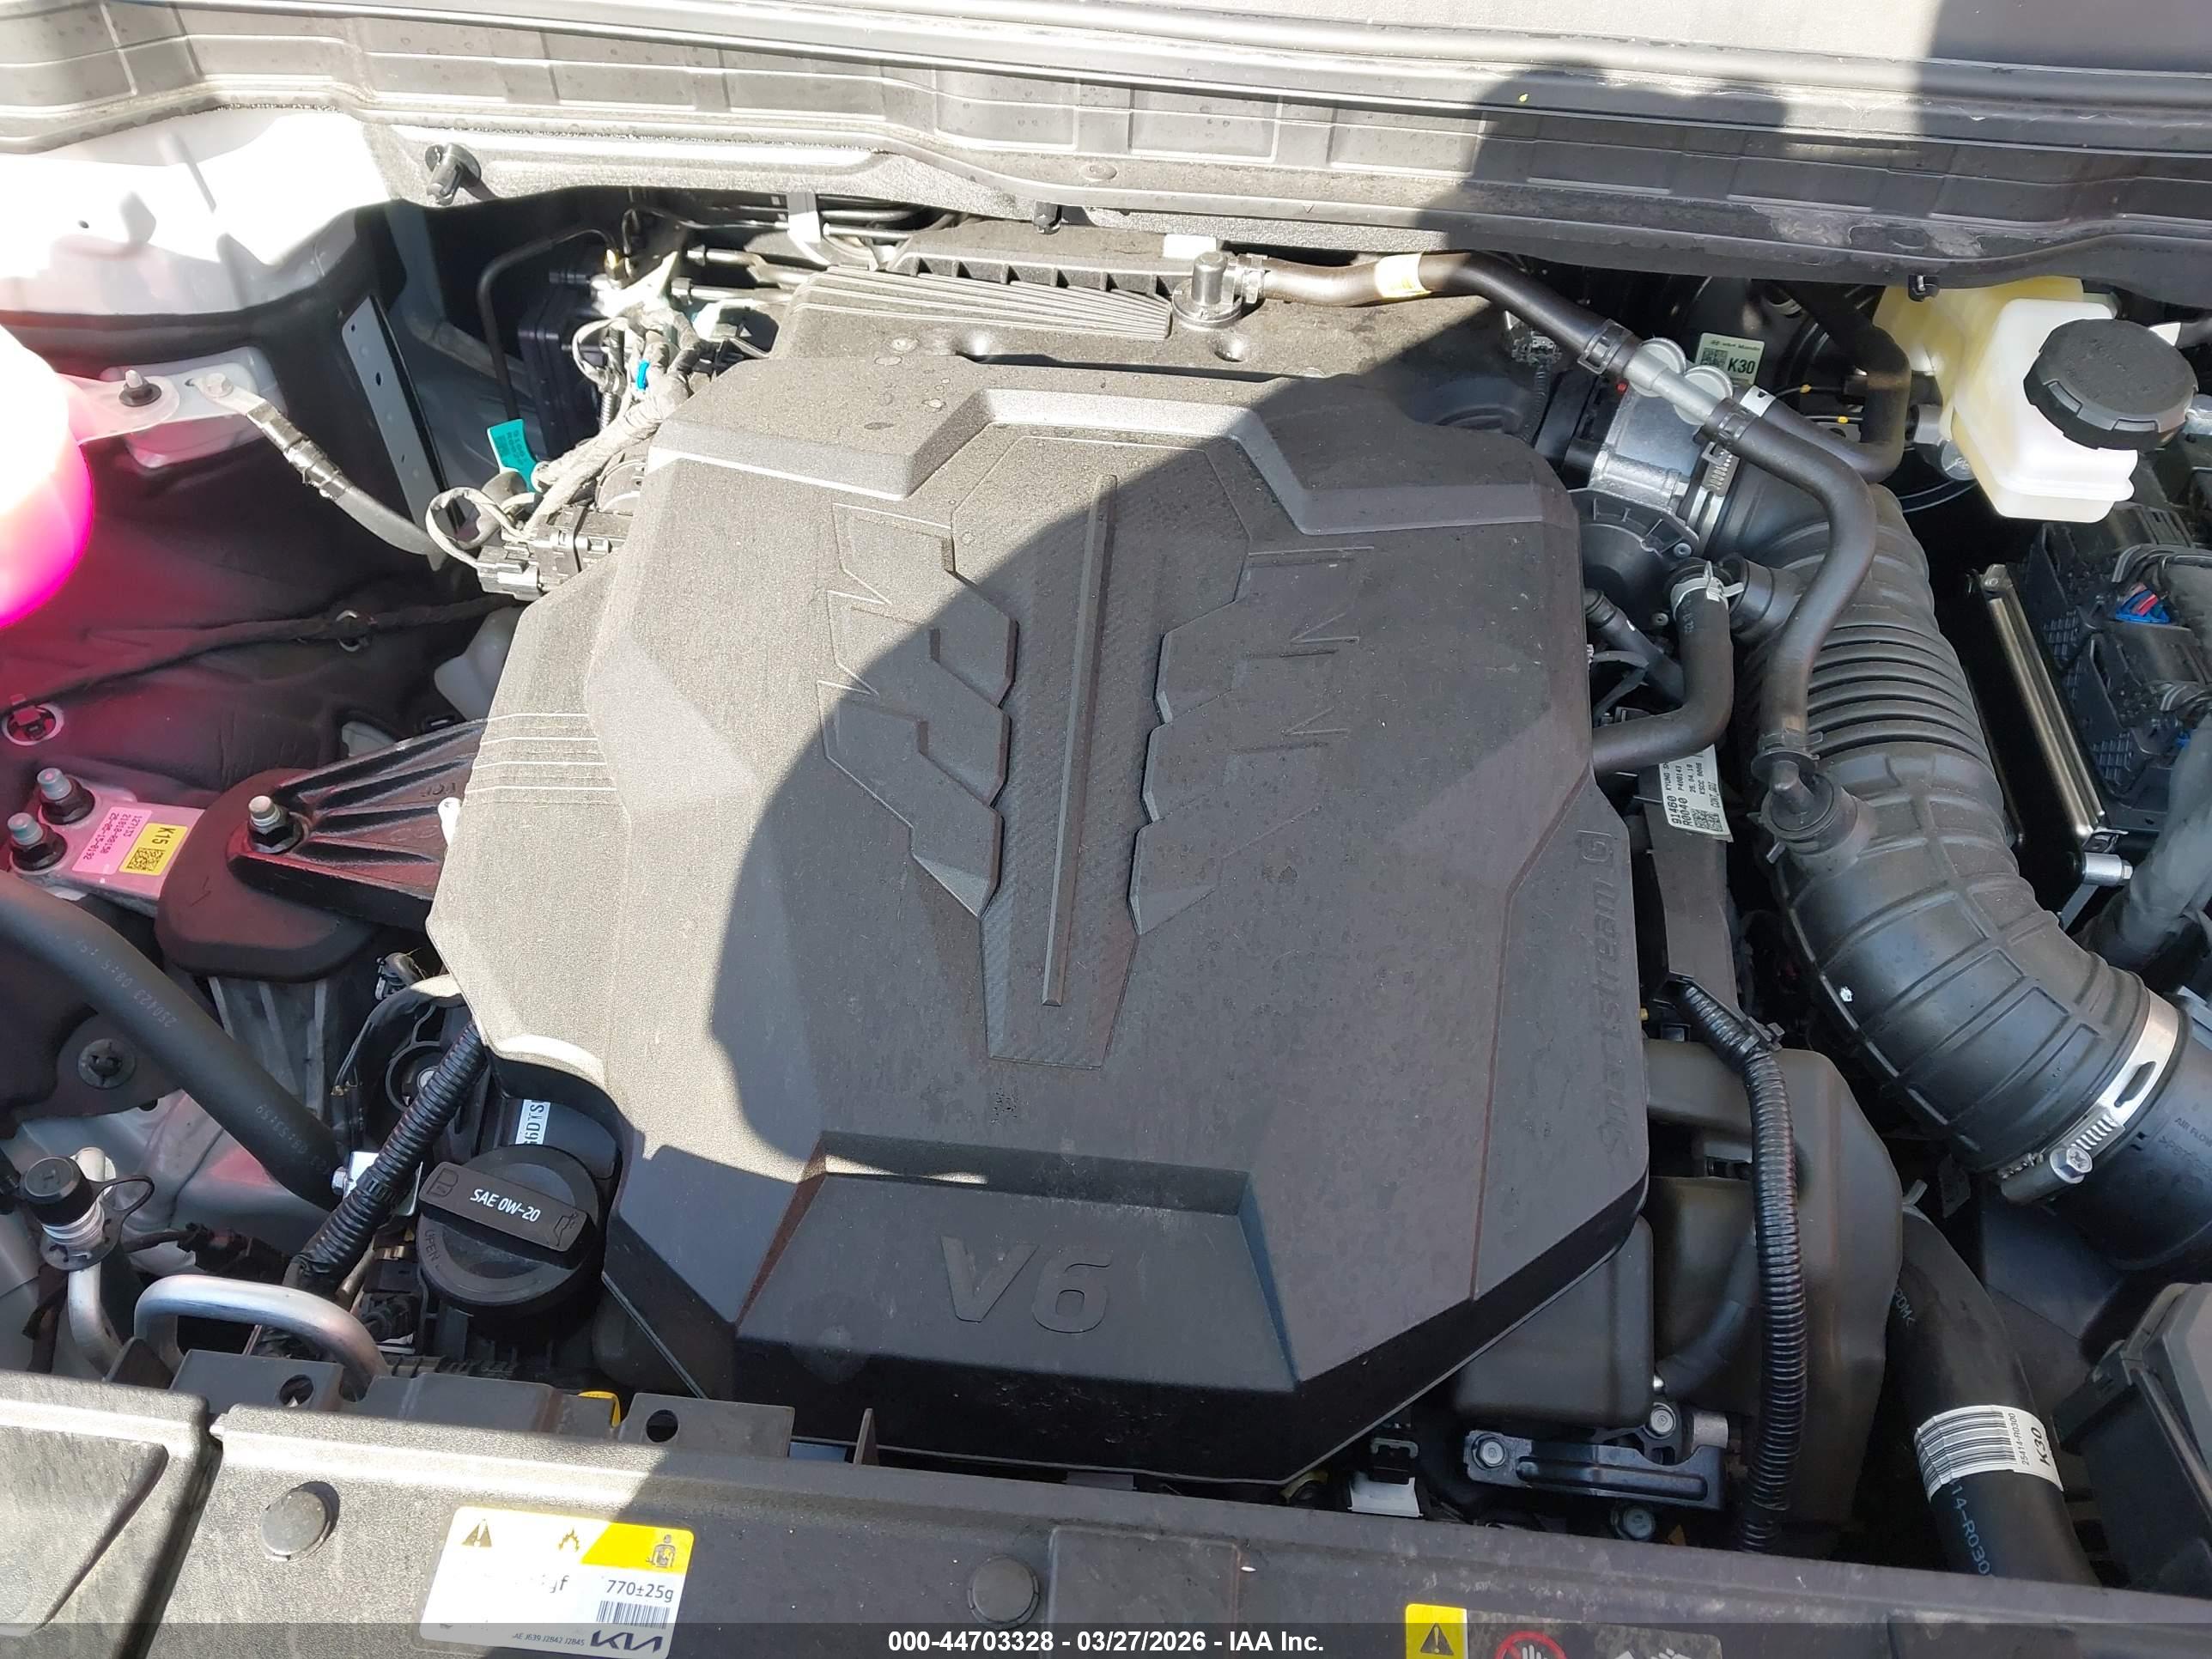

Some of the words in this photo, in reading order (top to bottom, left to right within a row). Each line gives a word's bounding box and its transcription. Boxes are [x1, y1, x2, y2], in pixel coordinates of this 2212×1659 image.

[1727, 357, 1756, 374] K30
[1667, 795, 1682, 824] 91460
[1678, 796, 1693, 827] R0040
[152, 827, 176, 845] K15
[470, 1188, 498, 1208] SAE
[497, 1196, 542, 1223] 0W-20
[939, 1234, 1114, 1334] V6
[2031, 1427, 2051, 1467] K30
[605, 1579, 675, 1603] 770±25g
